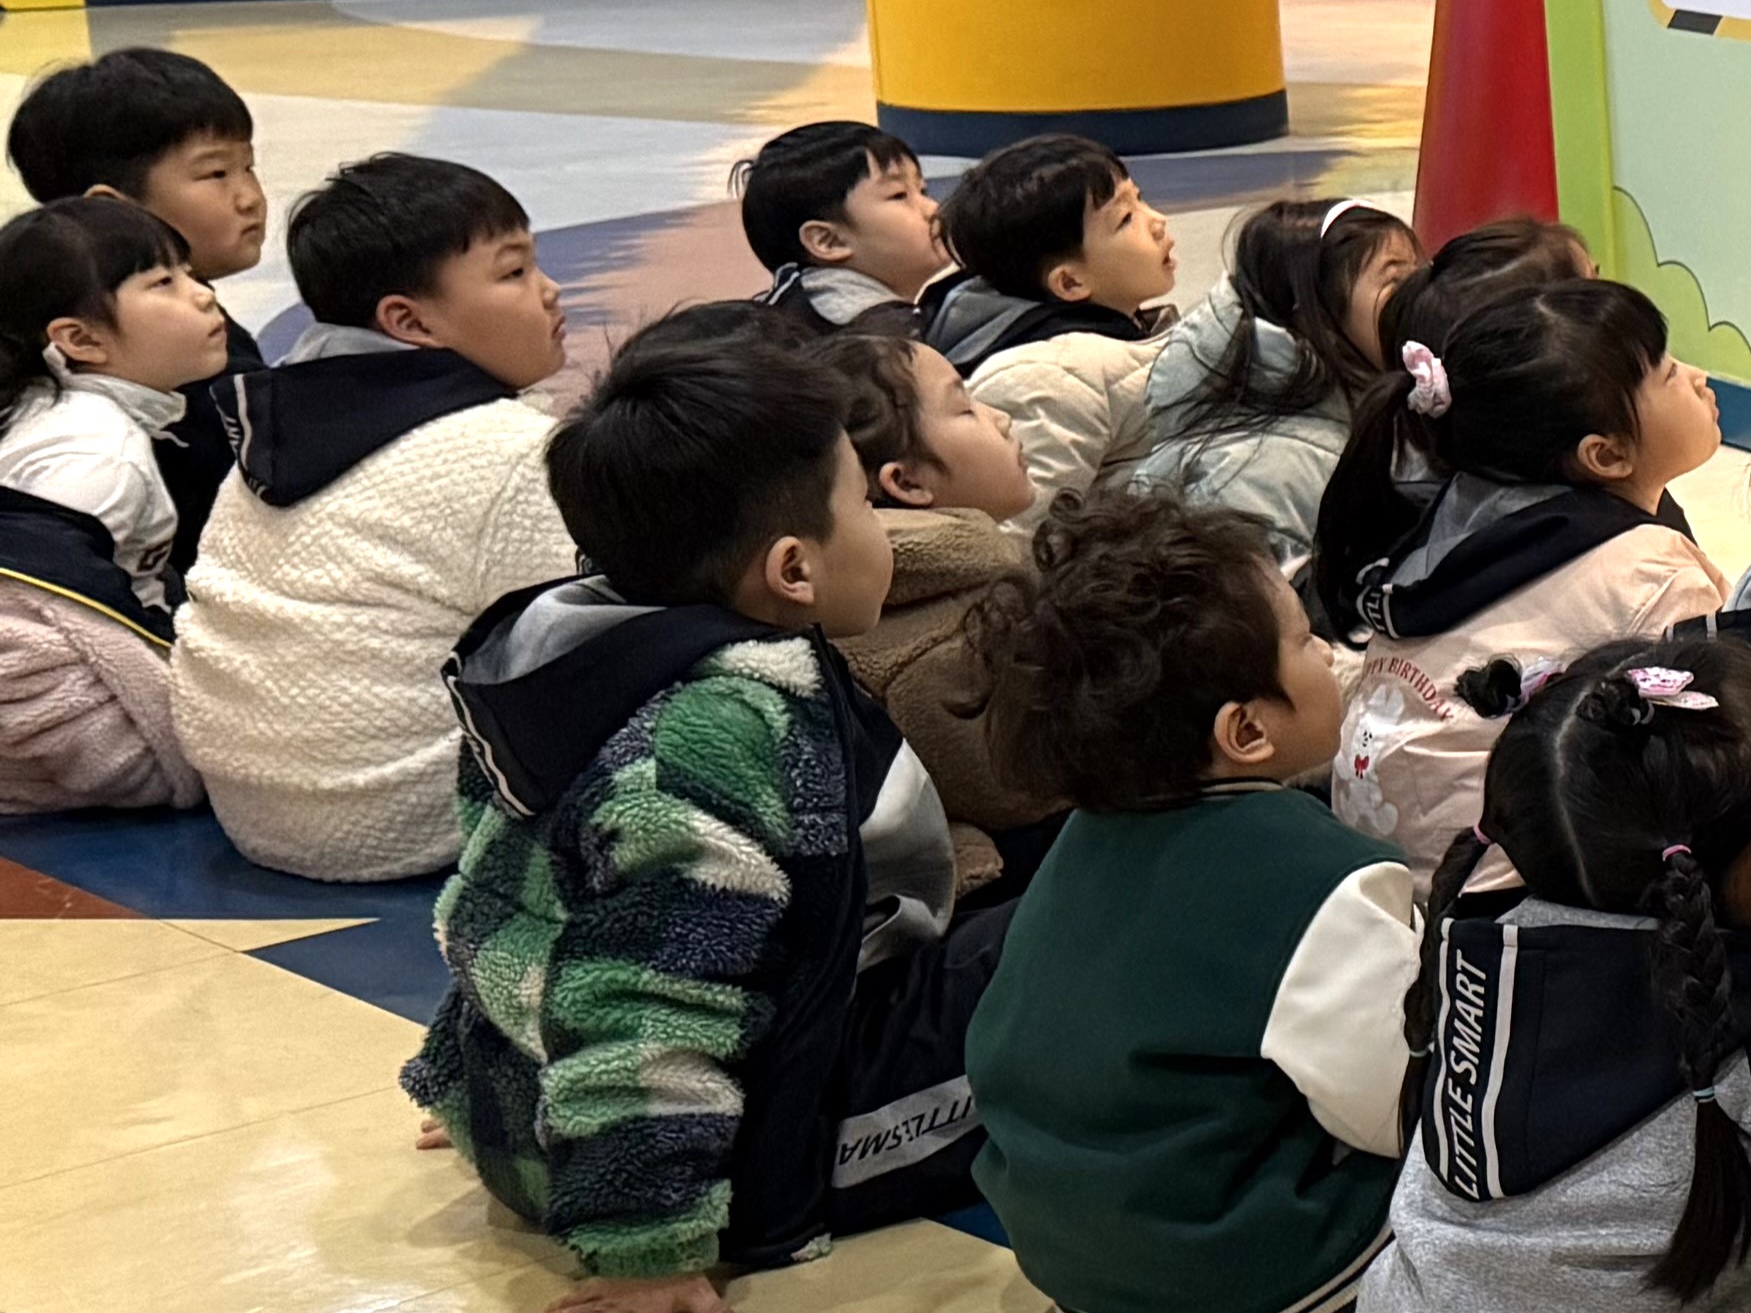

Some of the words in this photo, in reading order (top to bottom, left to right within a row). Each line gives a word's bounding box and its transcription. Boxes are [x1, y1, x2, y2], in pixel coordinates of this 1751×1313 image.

[1388, 657, 1454, 721] BIRTHDAY
[1450, 948, 1487, 1086] SMART
[838, 1124, 903, 1166] SMA
[902, 1095, 973, 1142] ITTLE
[1447, 1077, 1481, 1201] LITTLE
